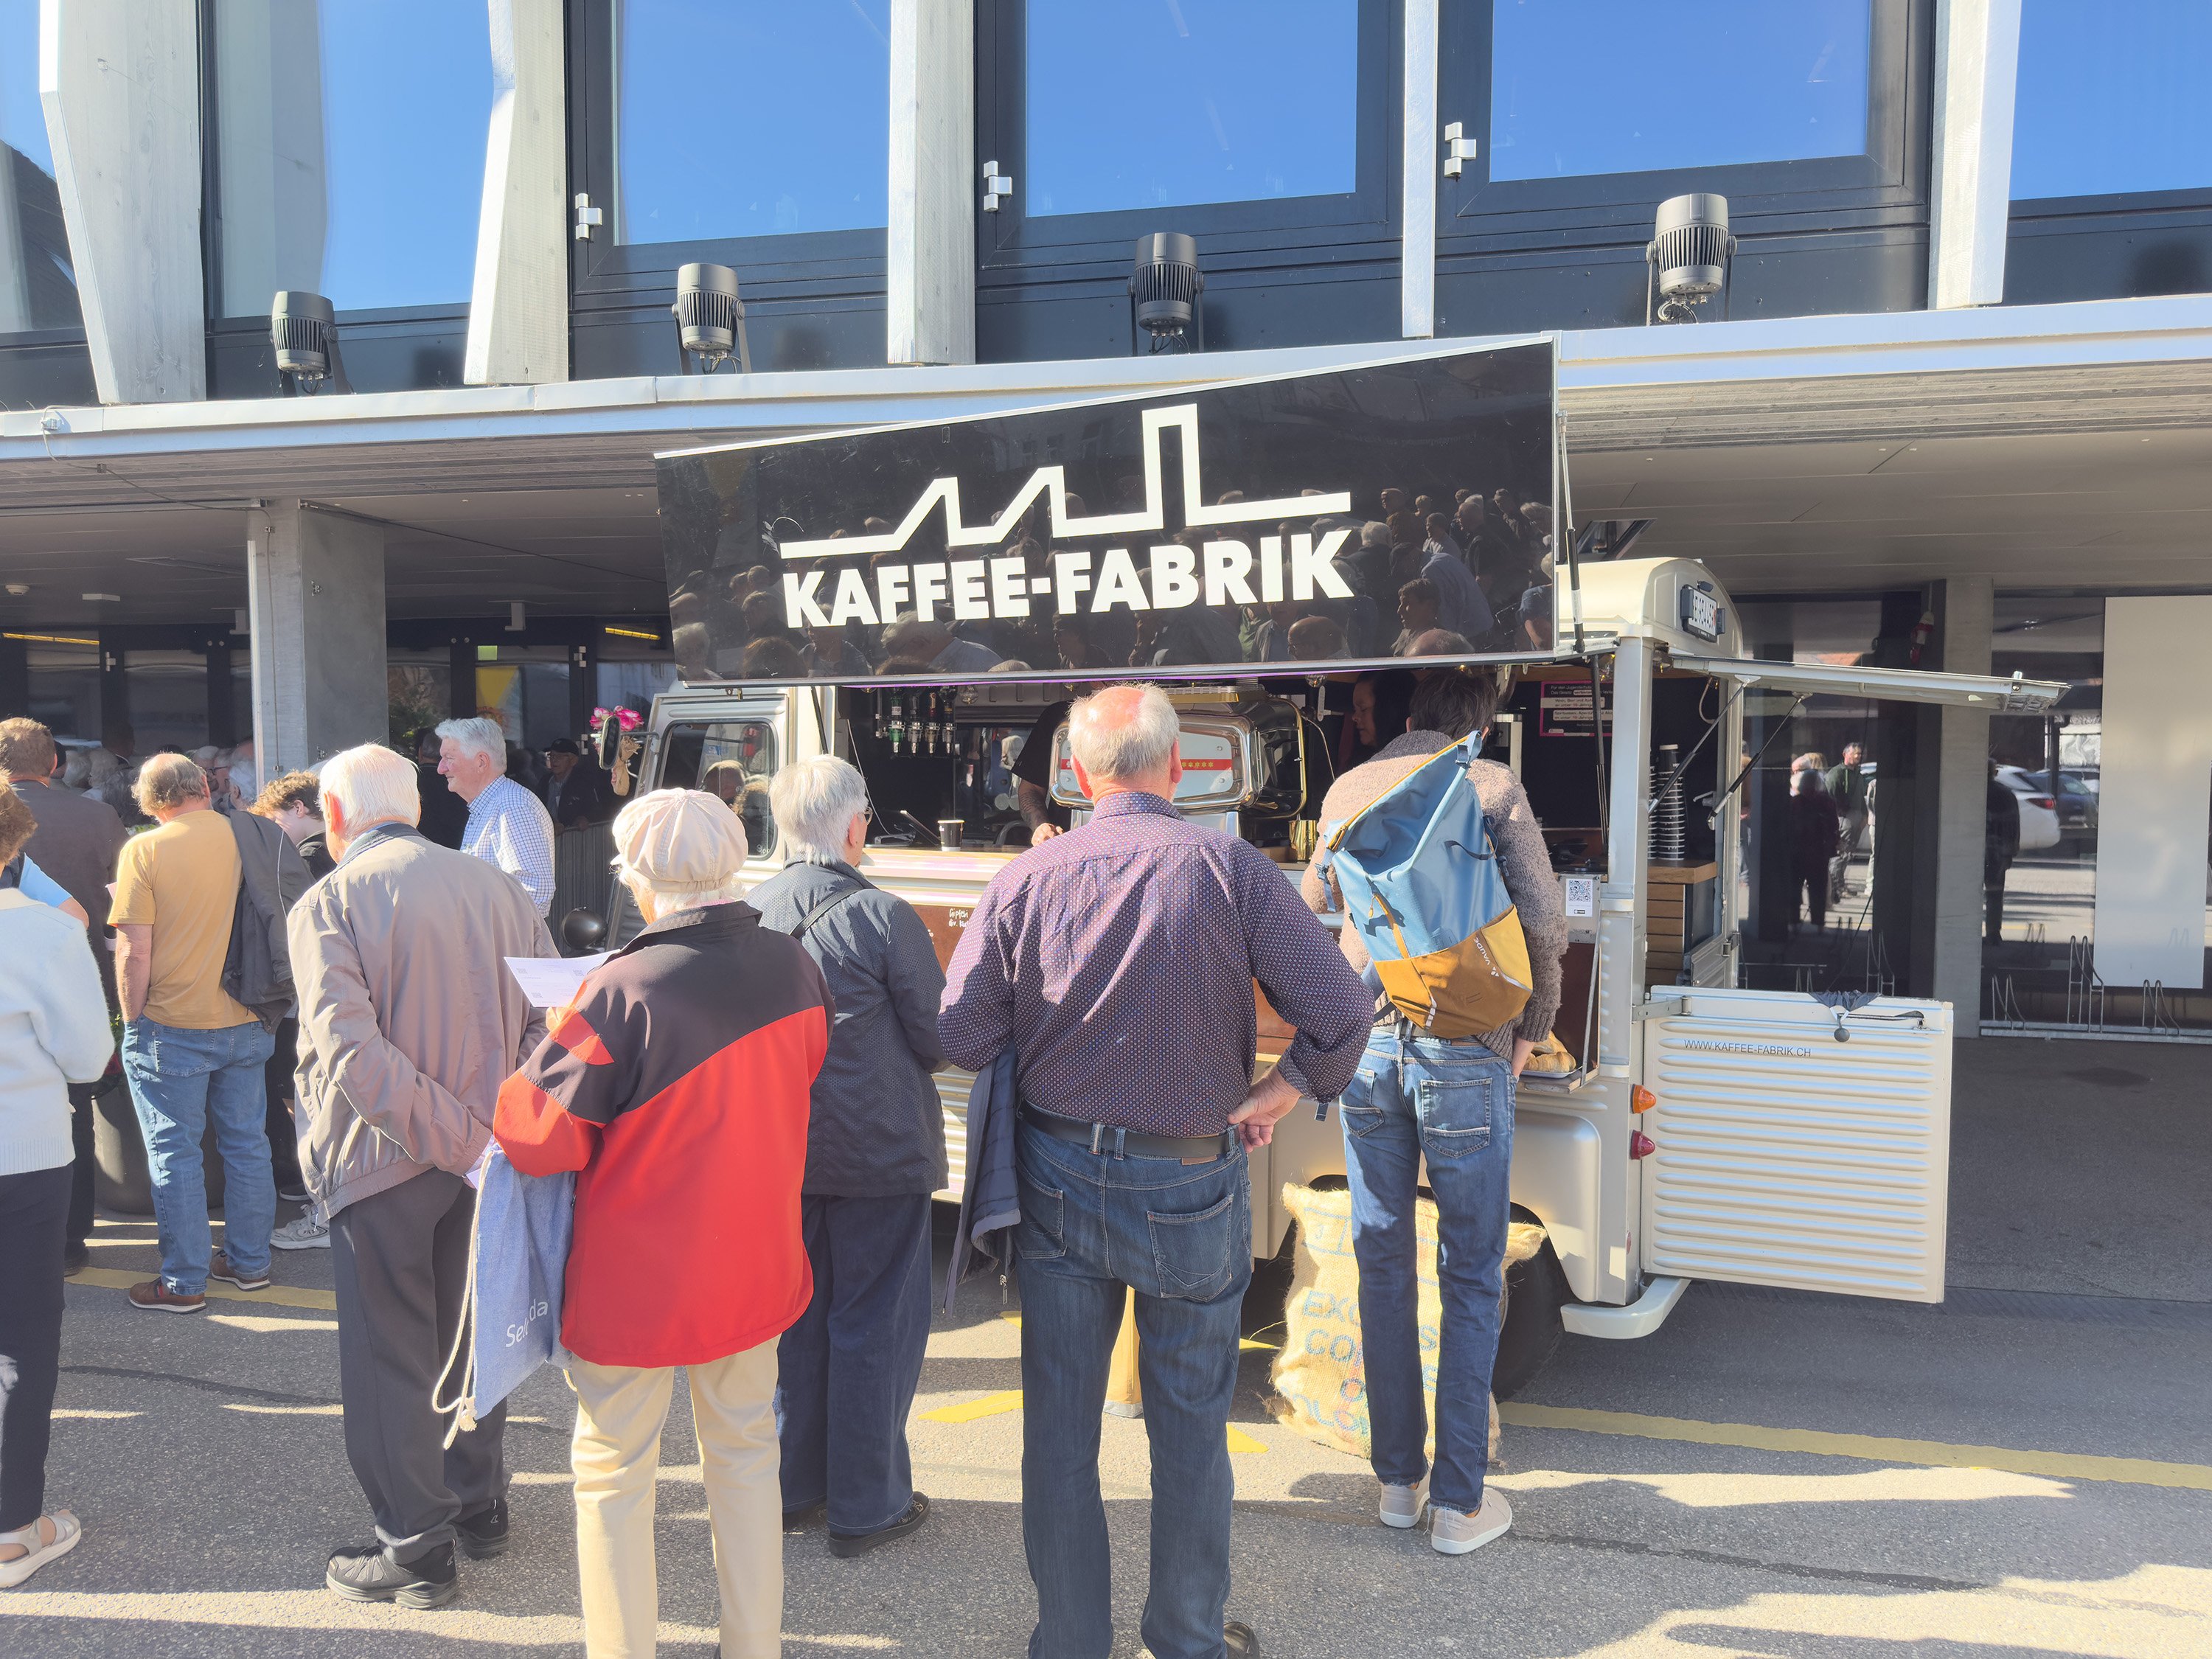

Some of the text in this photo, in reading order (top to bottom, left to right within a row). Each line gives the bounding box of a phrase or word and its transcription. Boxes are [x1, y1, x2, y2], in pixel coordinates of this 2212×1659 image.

[782, 529, 1354, 629] KAFFEE-FABRIK
[1474, 937, 1490, 965] VAUDE
[1684, 1040, 1811, 1057] WWW.KAFFEE-FABRIK.CH
